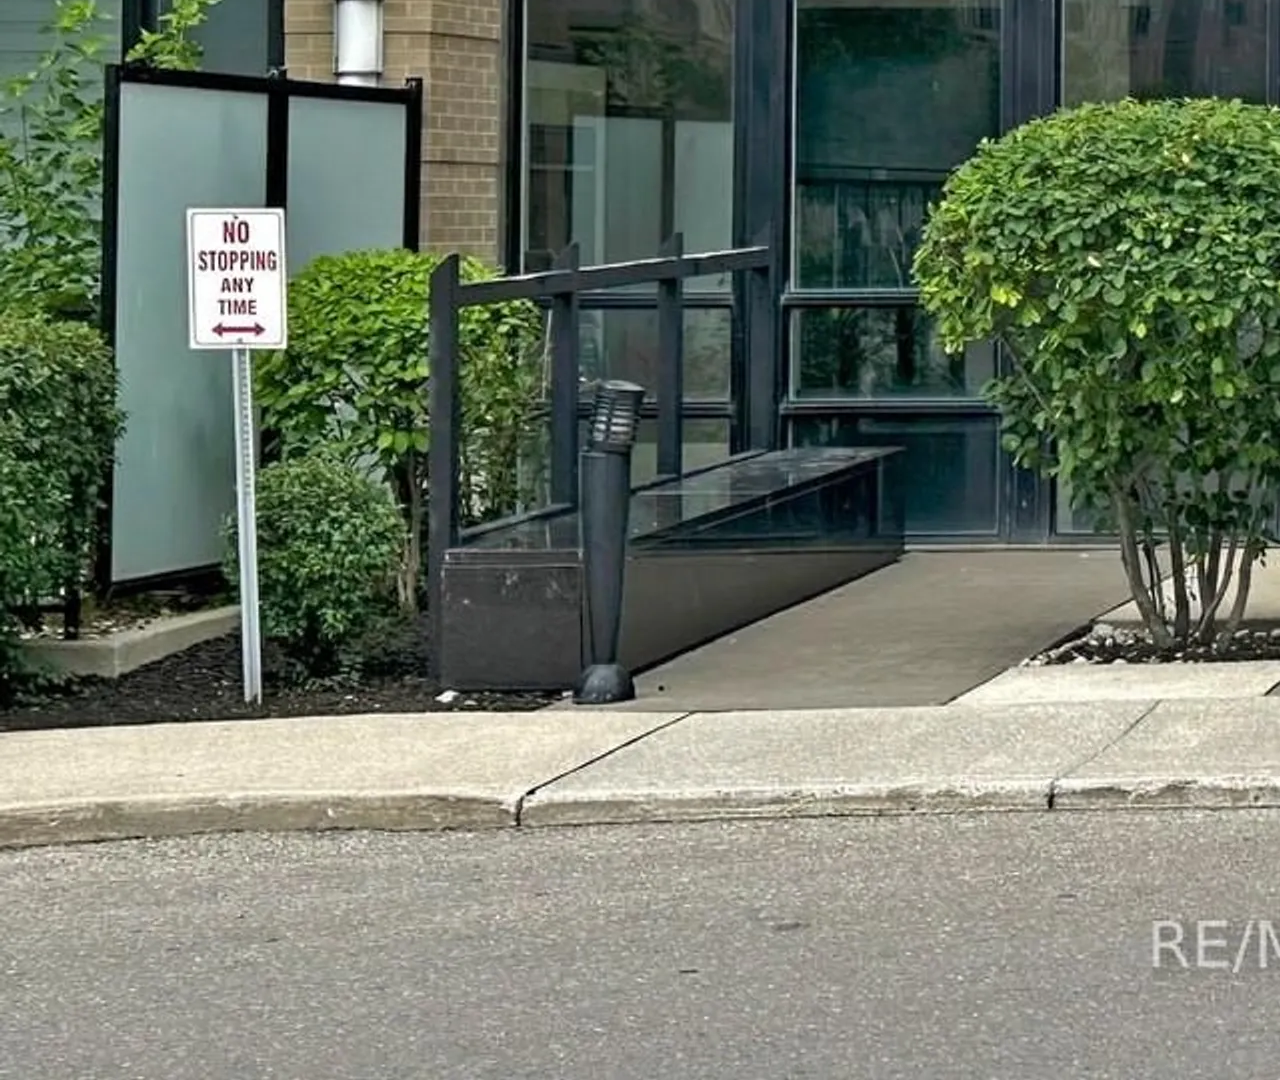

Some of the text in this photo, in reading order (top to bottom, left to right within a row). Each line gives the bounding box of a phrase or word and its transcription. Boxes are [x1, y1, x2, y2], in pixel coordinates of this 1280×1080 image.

[223, 220, 250, 244] NO
[198, 250, 277, 271] STOPPING
[221, 277, 254, 293] ANY
[218, 299, 257, 315] TIME
